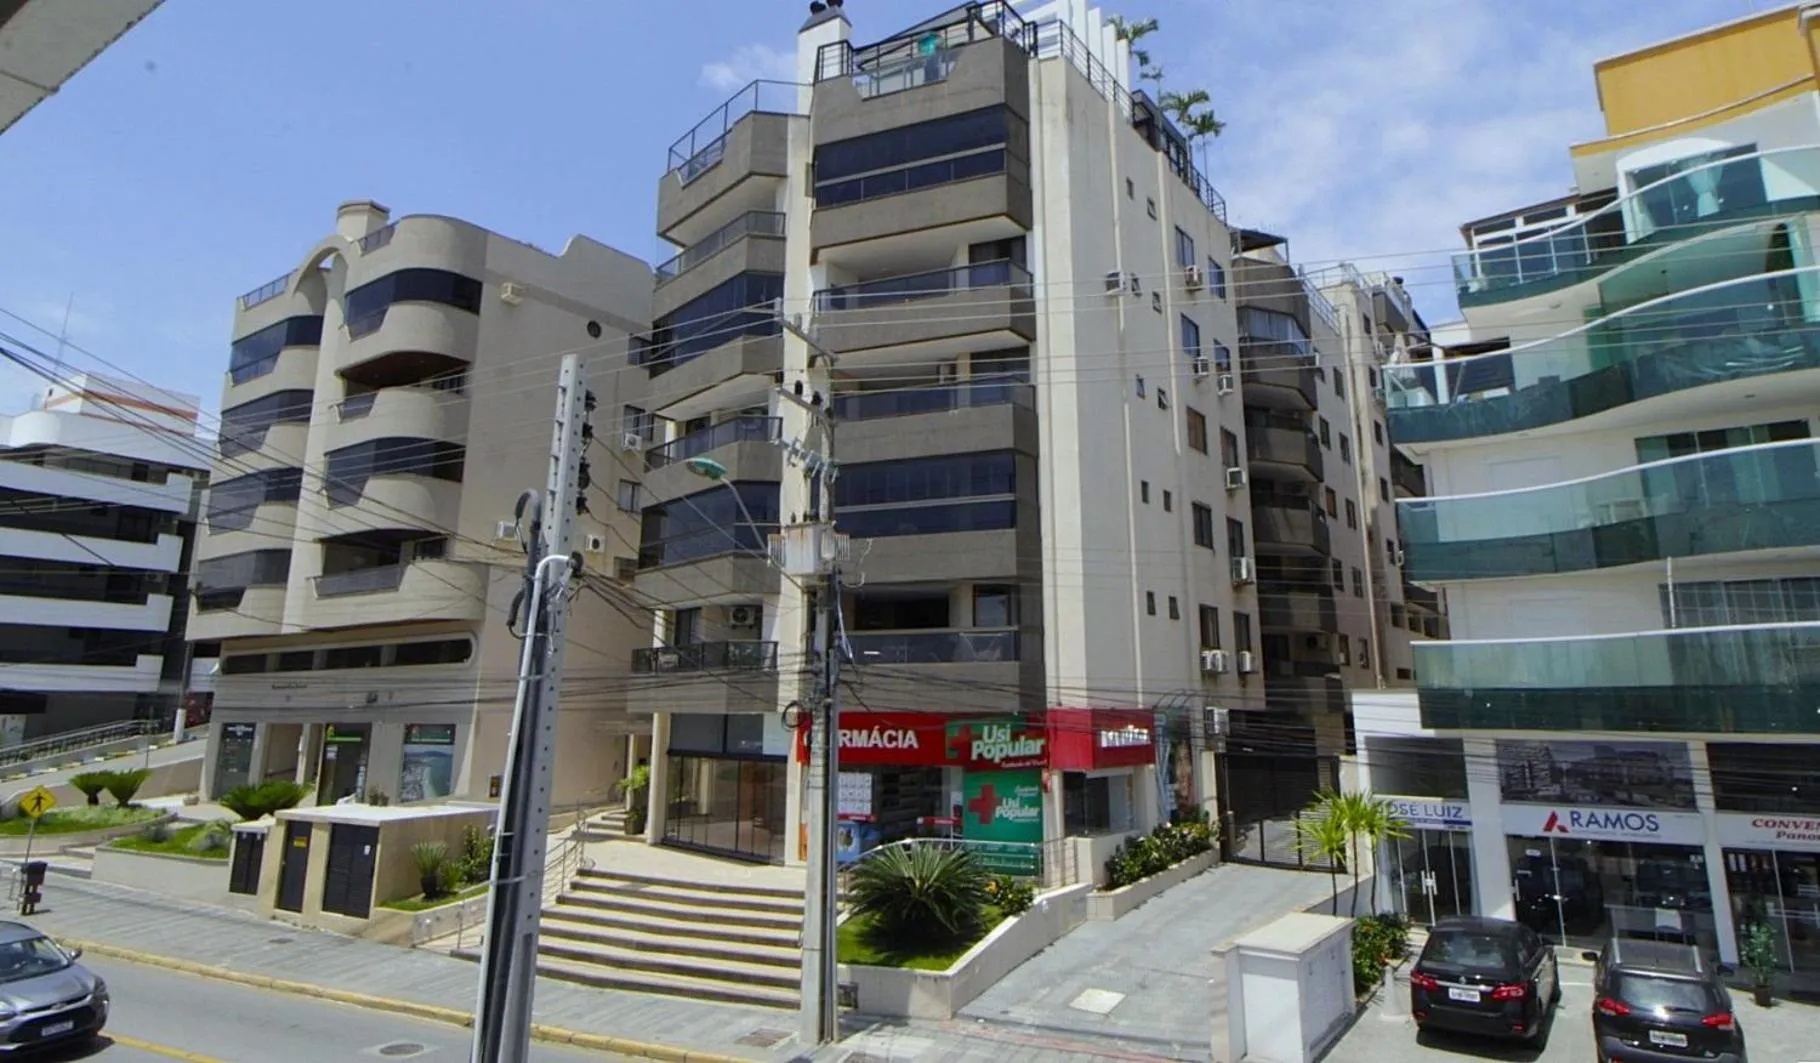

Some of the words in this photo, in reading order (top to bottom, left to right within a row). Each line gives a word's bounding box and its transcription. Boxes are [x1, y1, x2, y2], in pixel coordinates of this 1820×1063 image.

[803, 726, 919, 749] RMÁCIA
[982, 724, 1011, 744] Usi
[971, 734, 1046, 764] Popular
[1424, 804, 1463, 818] LUIZ
[1570, 810, 1660, 832] RAMOS
[1752, 819, 1820, 830] CONVE
